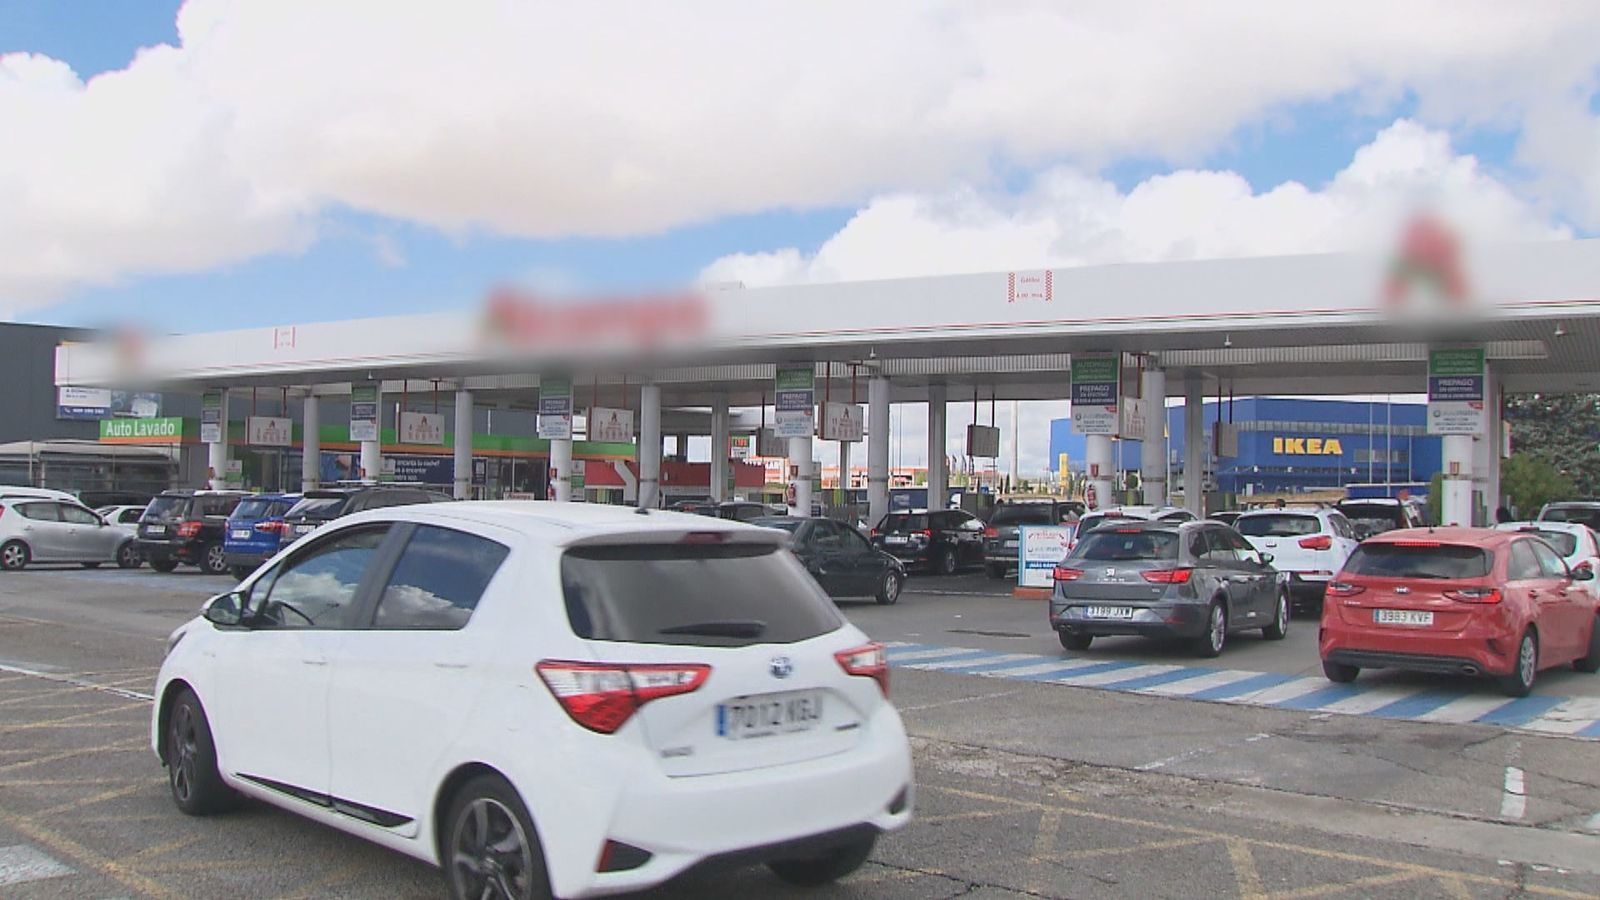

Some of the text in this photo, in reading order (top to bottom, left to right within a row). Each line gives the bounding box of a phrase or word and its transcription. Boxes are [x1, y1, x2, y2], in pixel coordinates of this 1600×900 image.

[106, 419, 175, 437] Auto Lavado
[1273, 437, 1343, 455] IKEA
[1381, 609, 1430, 623] 3983 KVF
